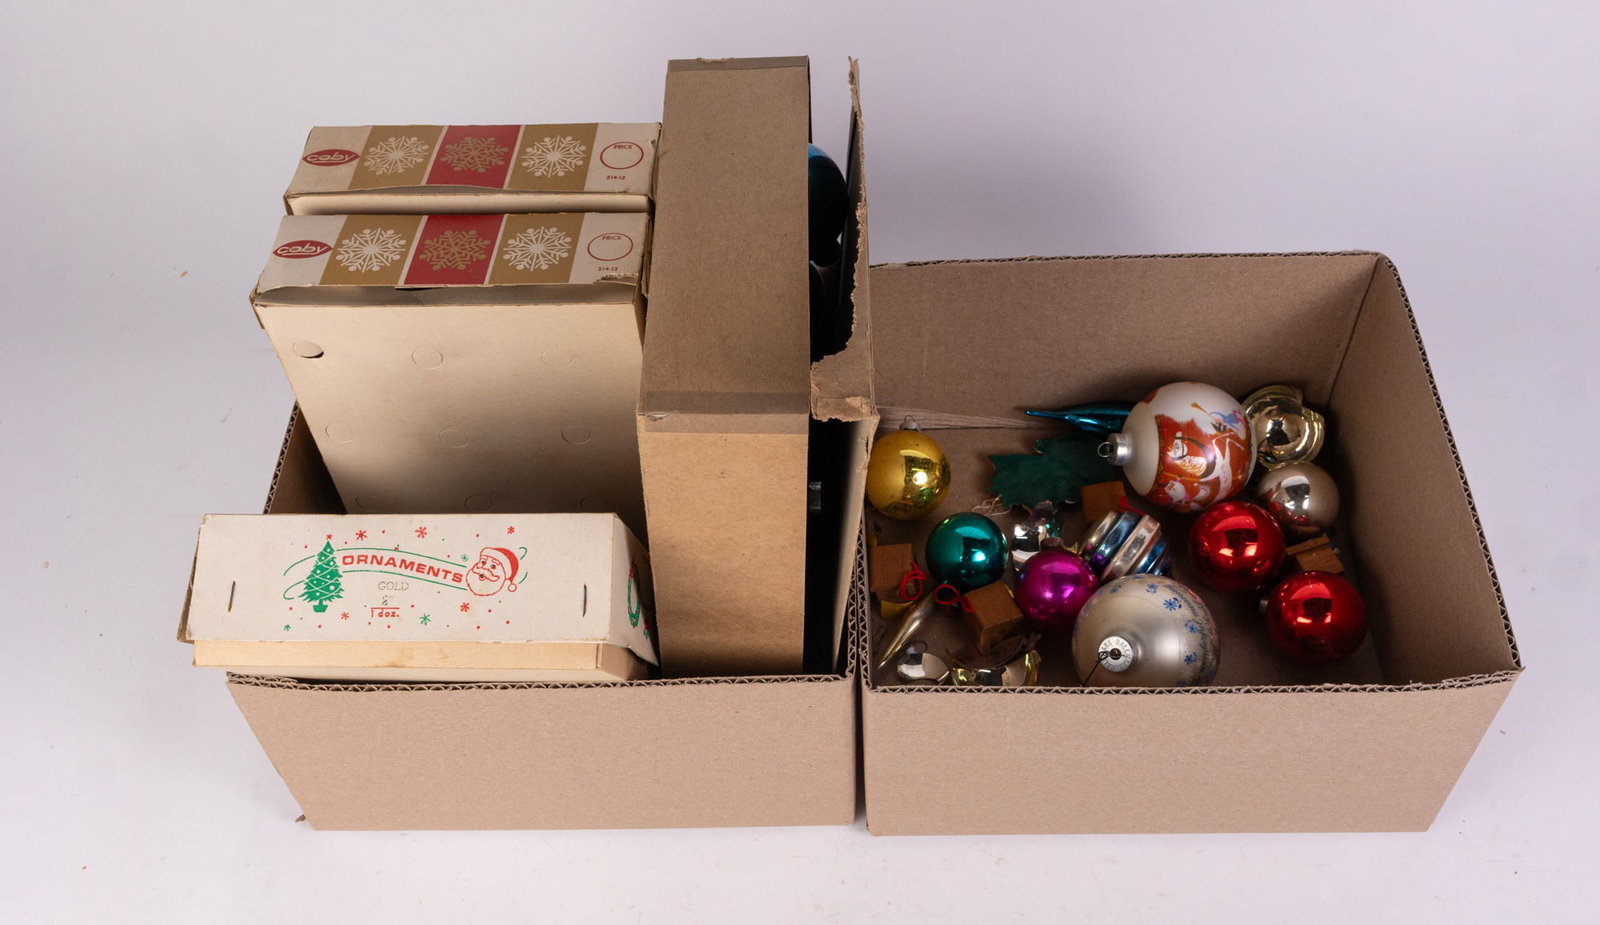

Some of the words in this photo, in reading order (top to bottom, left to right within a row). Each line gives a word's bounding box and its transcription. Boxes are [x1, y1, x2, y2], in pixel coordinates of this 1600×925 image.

[307, 152, 356, 164] coby
[277, 243, 328, 256] coby
[342, 554, 464, 583] ORNAMENTS
[378, 581, 409, 591] GOLD
[378, 609, 400, 618] doz.
